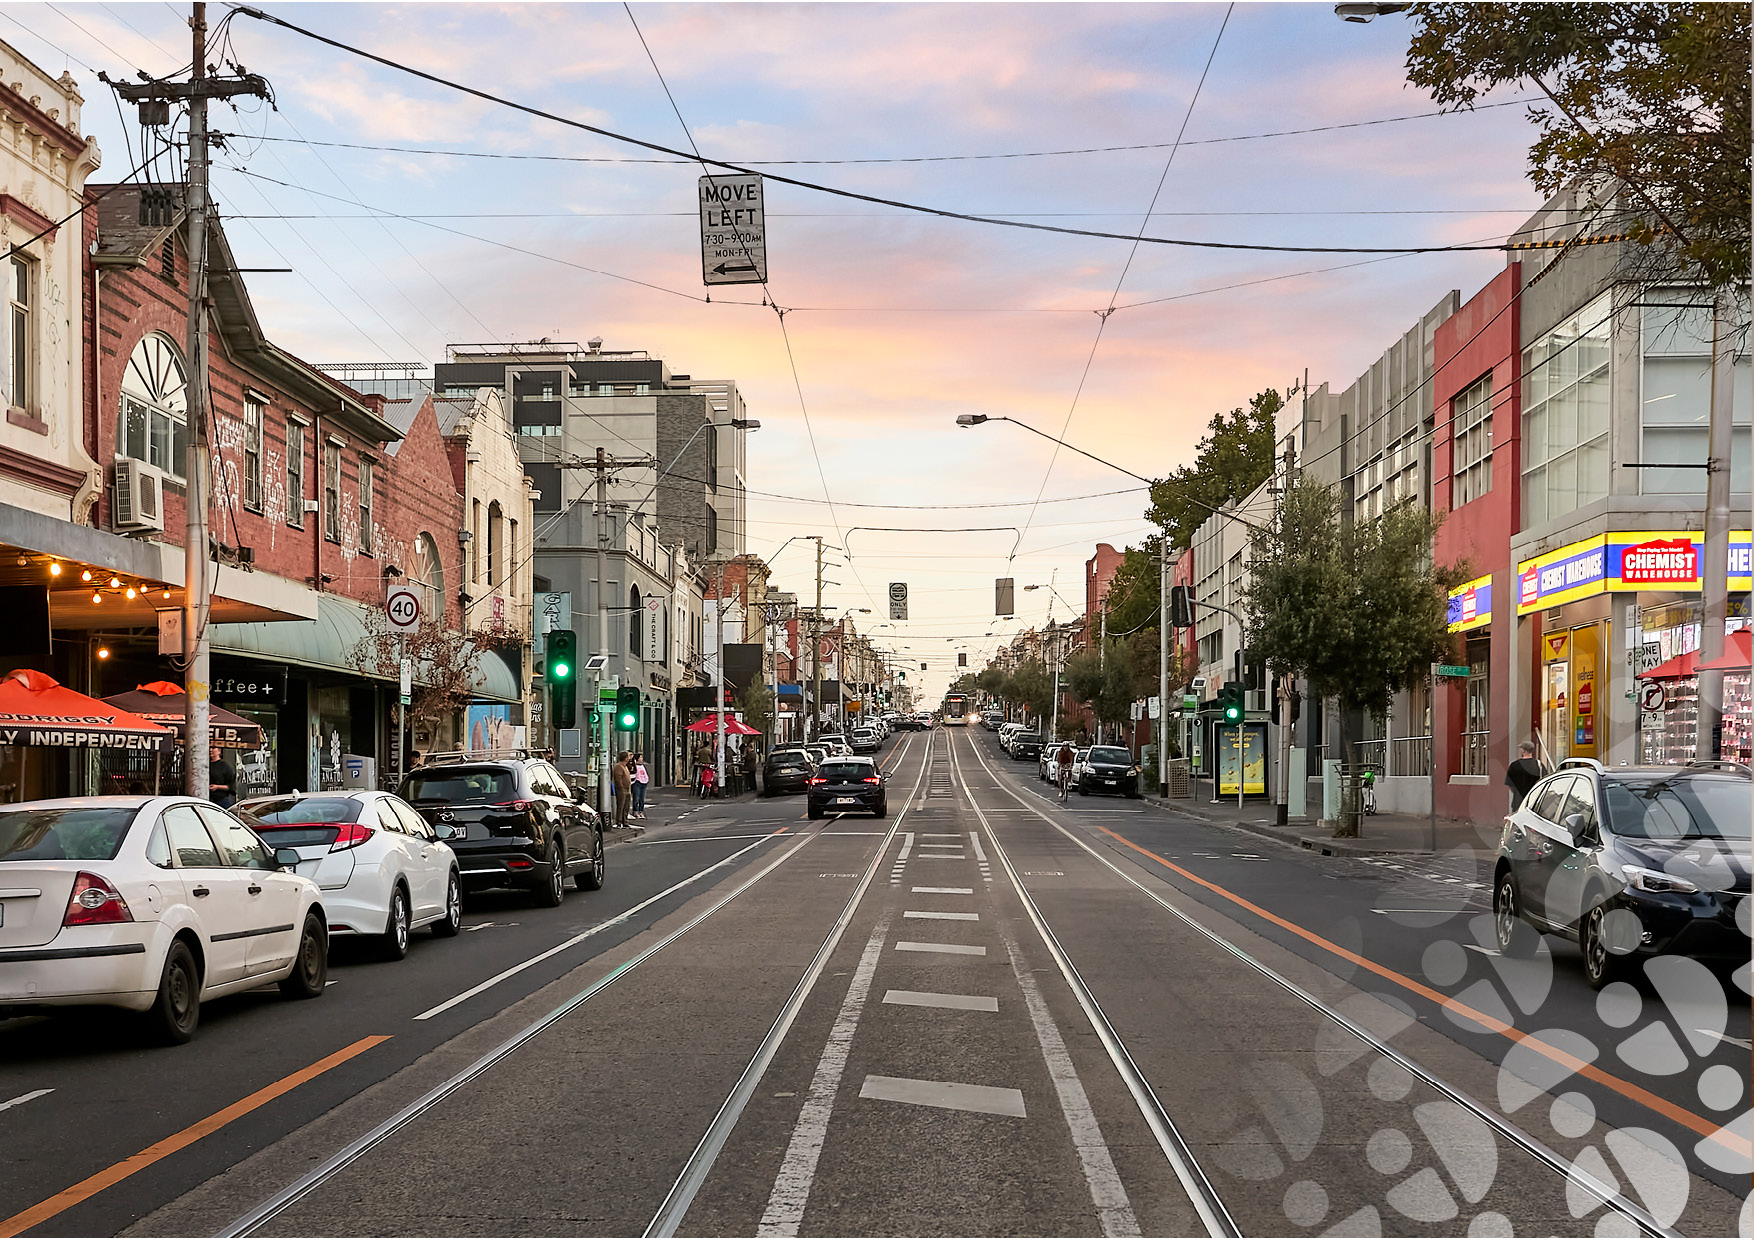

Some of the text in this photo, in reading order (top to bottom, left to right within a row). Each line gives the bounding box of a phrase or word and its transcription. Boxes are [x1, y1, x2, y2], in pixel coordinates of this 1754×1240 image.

[705, 184, 757, 202] MOVE
[708, 209, 756, 226] LEFT
[715, 249, 753, 257] MON-FRI
[1625, 553, 1695, 569] CHEMIST
[1727, 548, 1752, 571] HE
[1541, 552, 1602, 592] CHEMIST WAREHOUSE
[1625, 570, 1693, 579] WAREHOUSE
[392, 601, 414, 617] 40
[651, 649, 656, 659] CO
[1440, 666, 1456, 675] ROSE
[205, 679, 257, 693] ffee
[30, 730, 164, 750] INDEPENDENT
